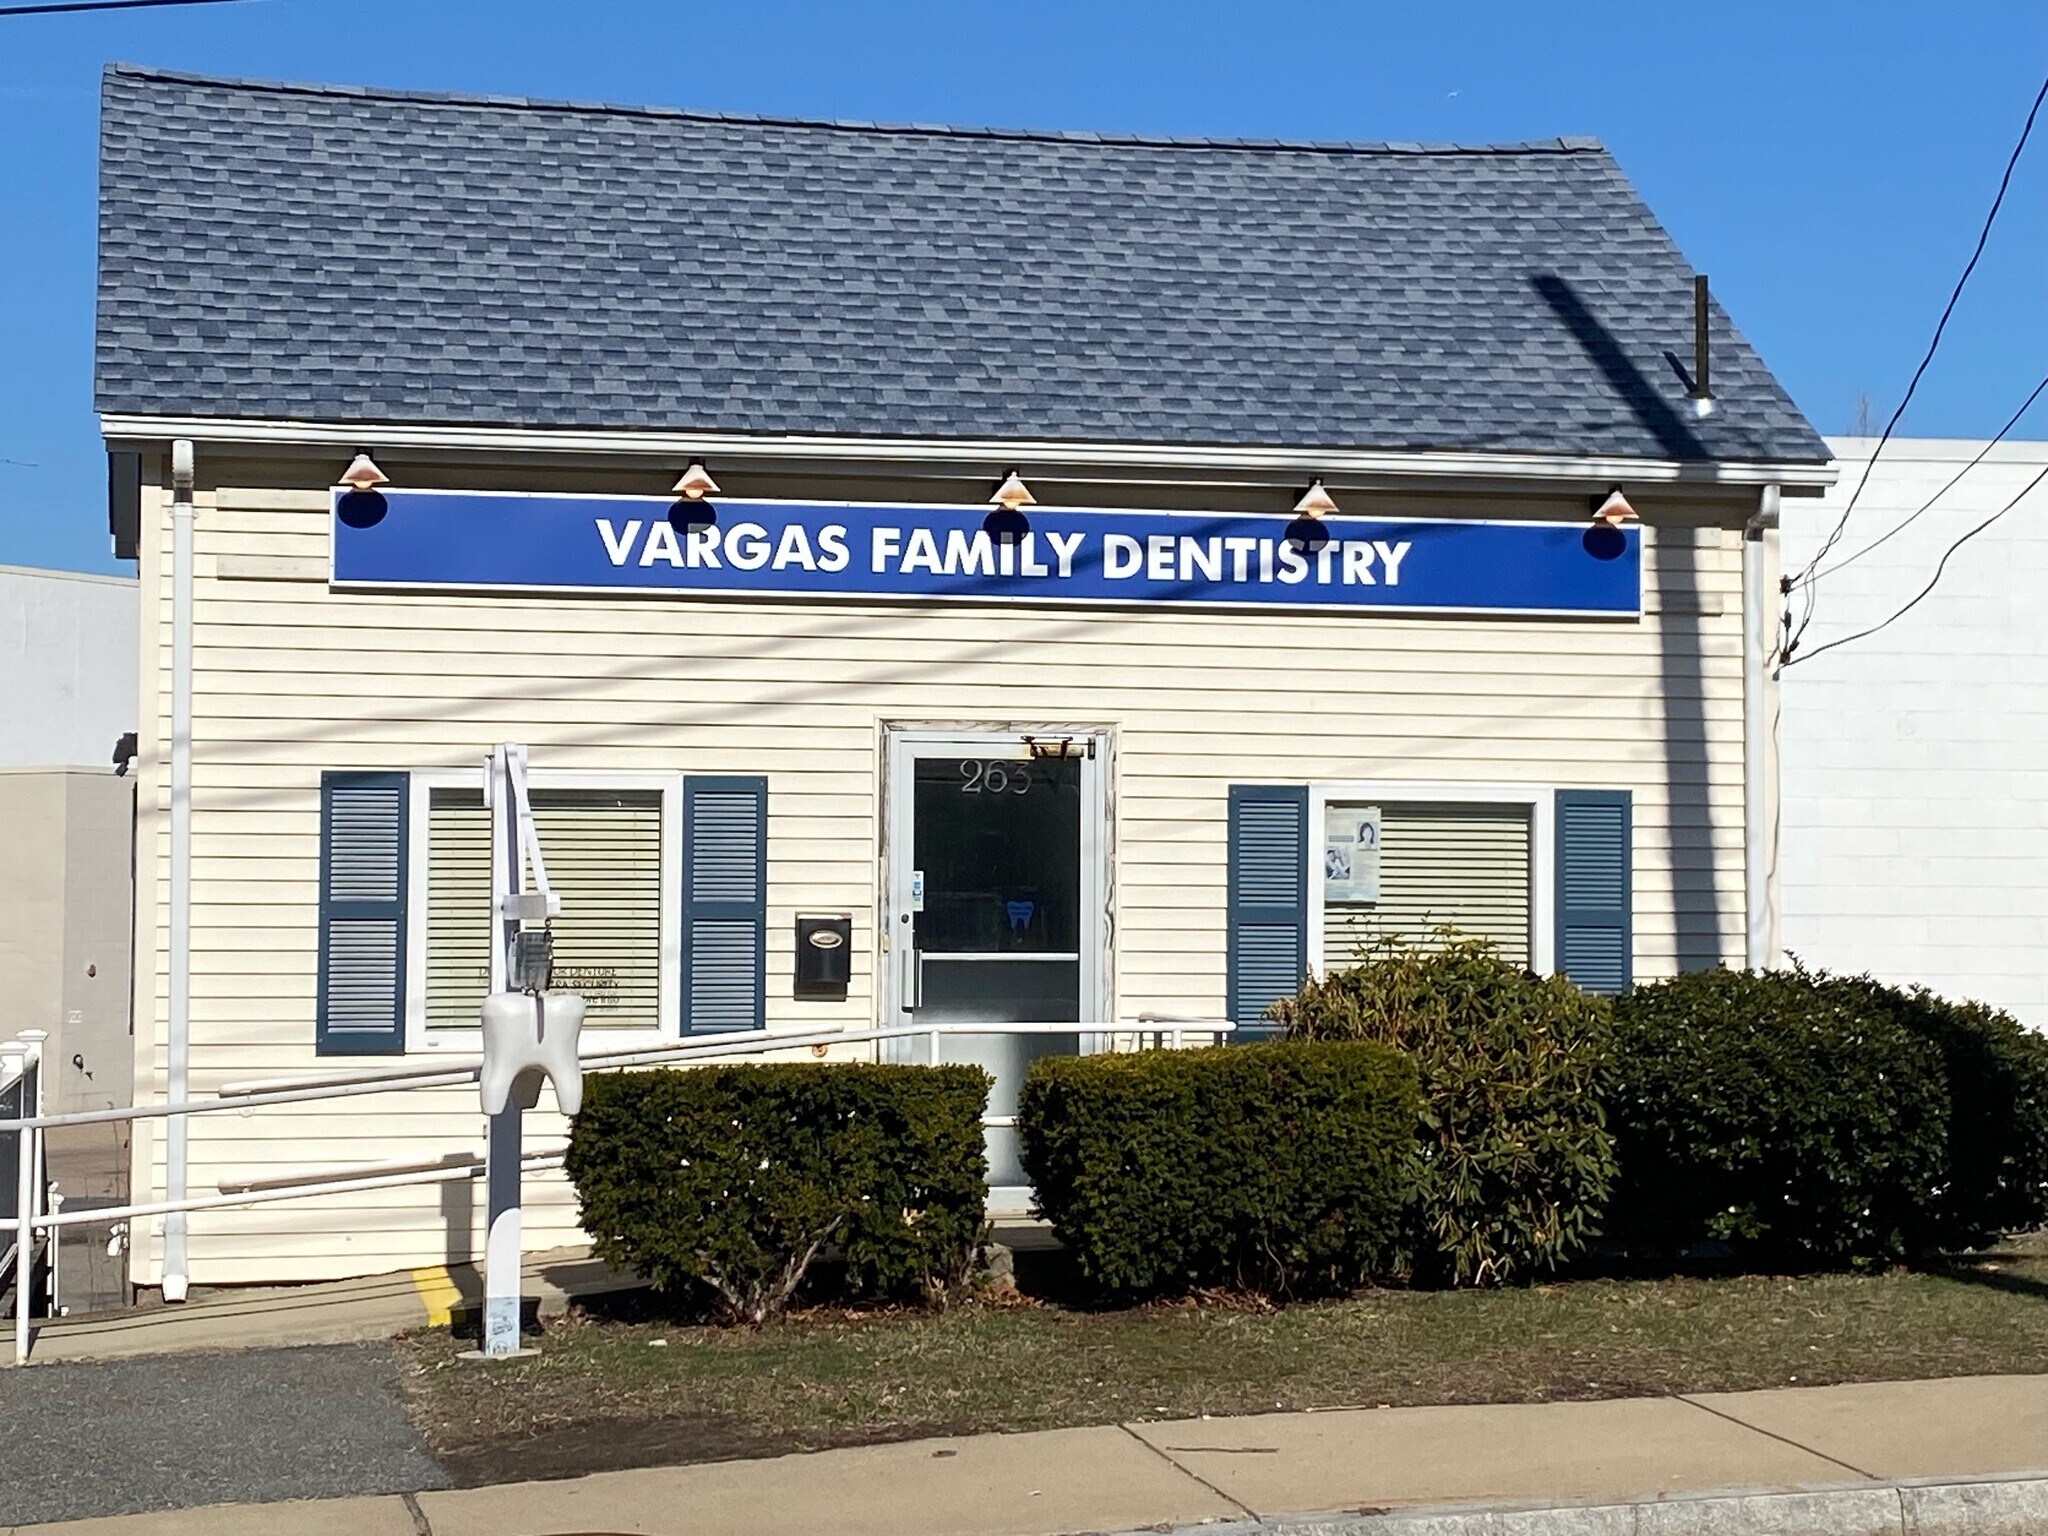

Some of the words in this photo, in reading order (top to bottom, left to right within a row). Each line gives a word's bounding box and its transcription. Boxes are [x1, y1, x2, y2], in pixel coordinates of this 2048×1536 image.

[595, 518, 850, 572] VARGAS
[872, 526, 1086, 577] FAMILY
[1103, 532, 1412, 586] DENTISTRY
[960, 760, 1032, 795] 263
